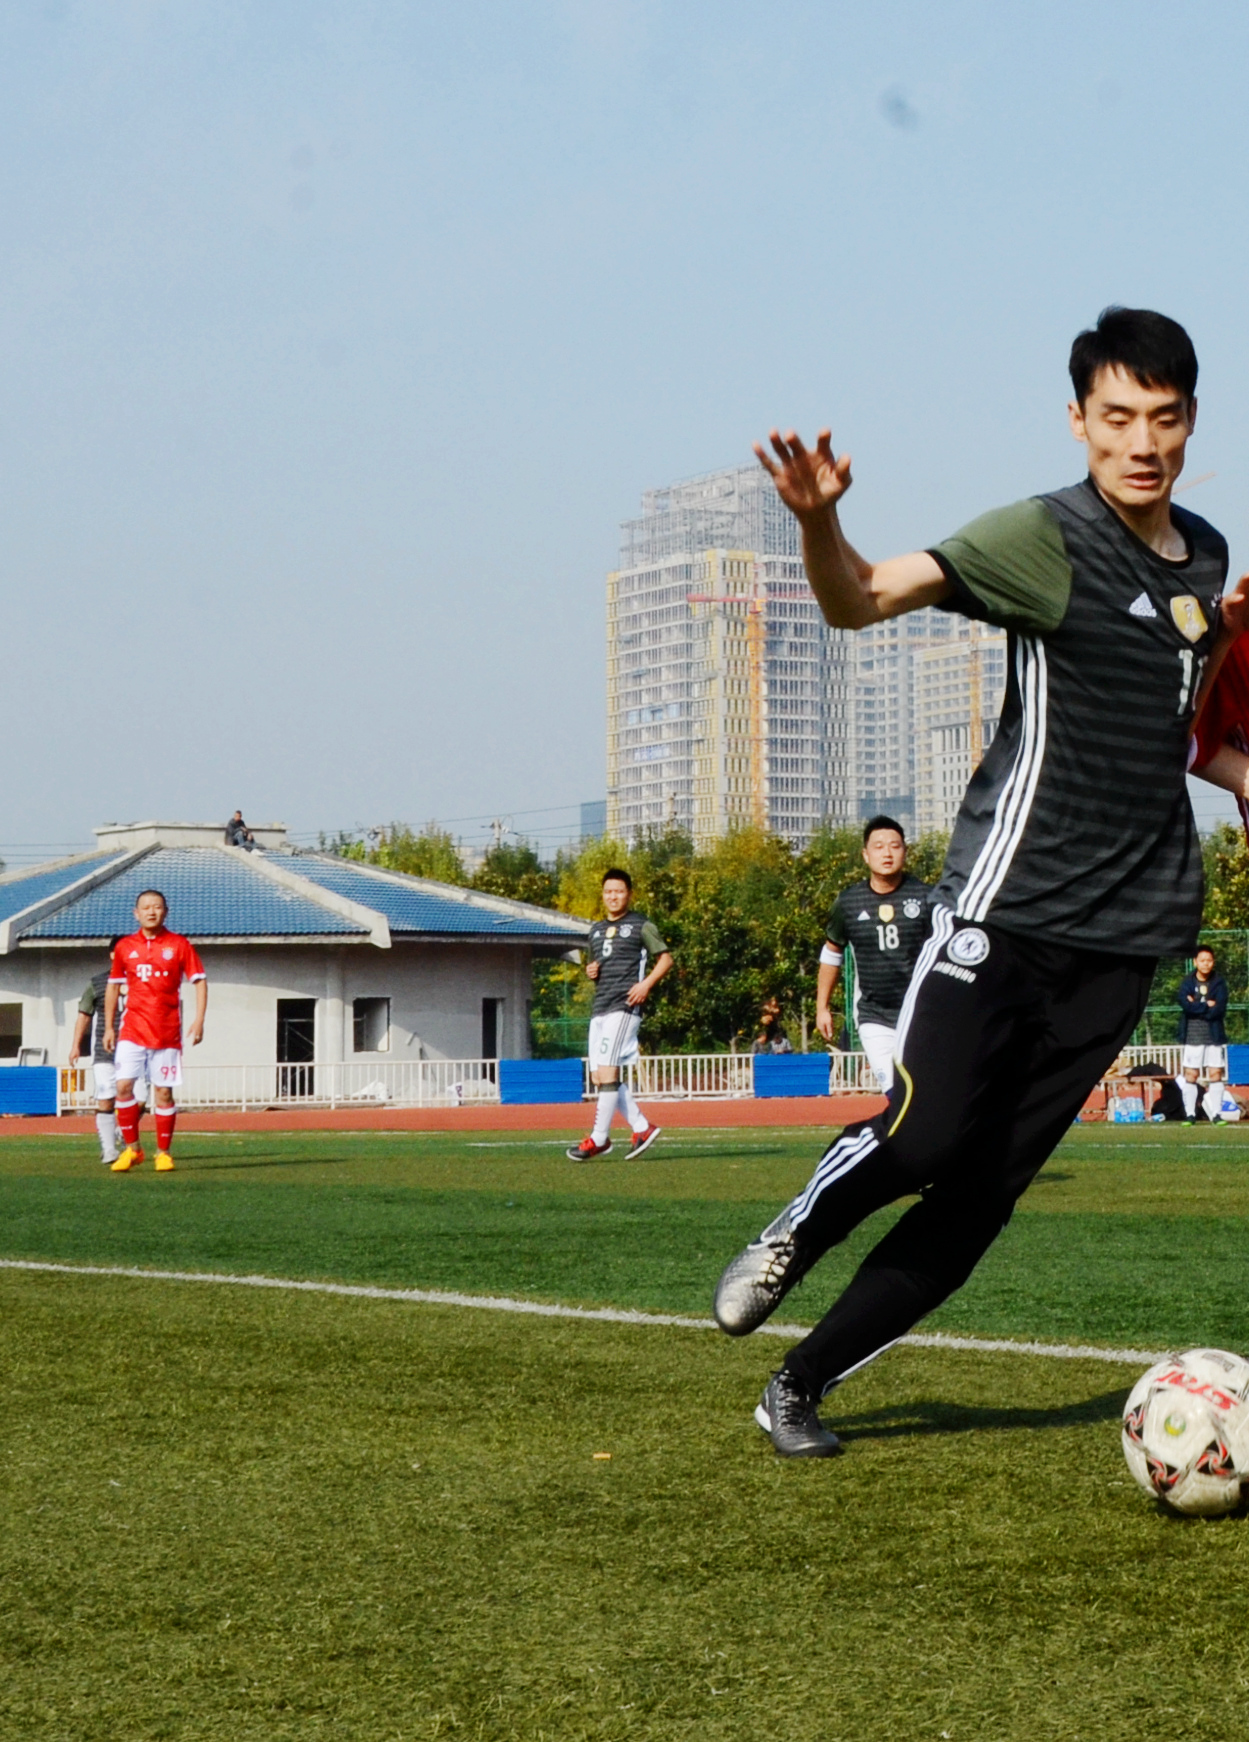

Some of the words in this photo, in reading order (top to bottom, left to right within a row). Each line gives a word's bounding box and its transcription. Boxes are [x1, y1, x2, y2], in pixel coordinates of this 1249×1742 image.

[876, 924, 900, 951] 18
[602, 939, 613, 957] 5
[600, 1037, 610, 1054] 5
[160, 1065, 177, 1081] 99
